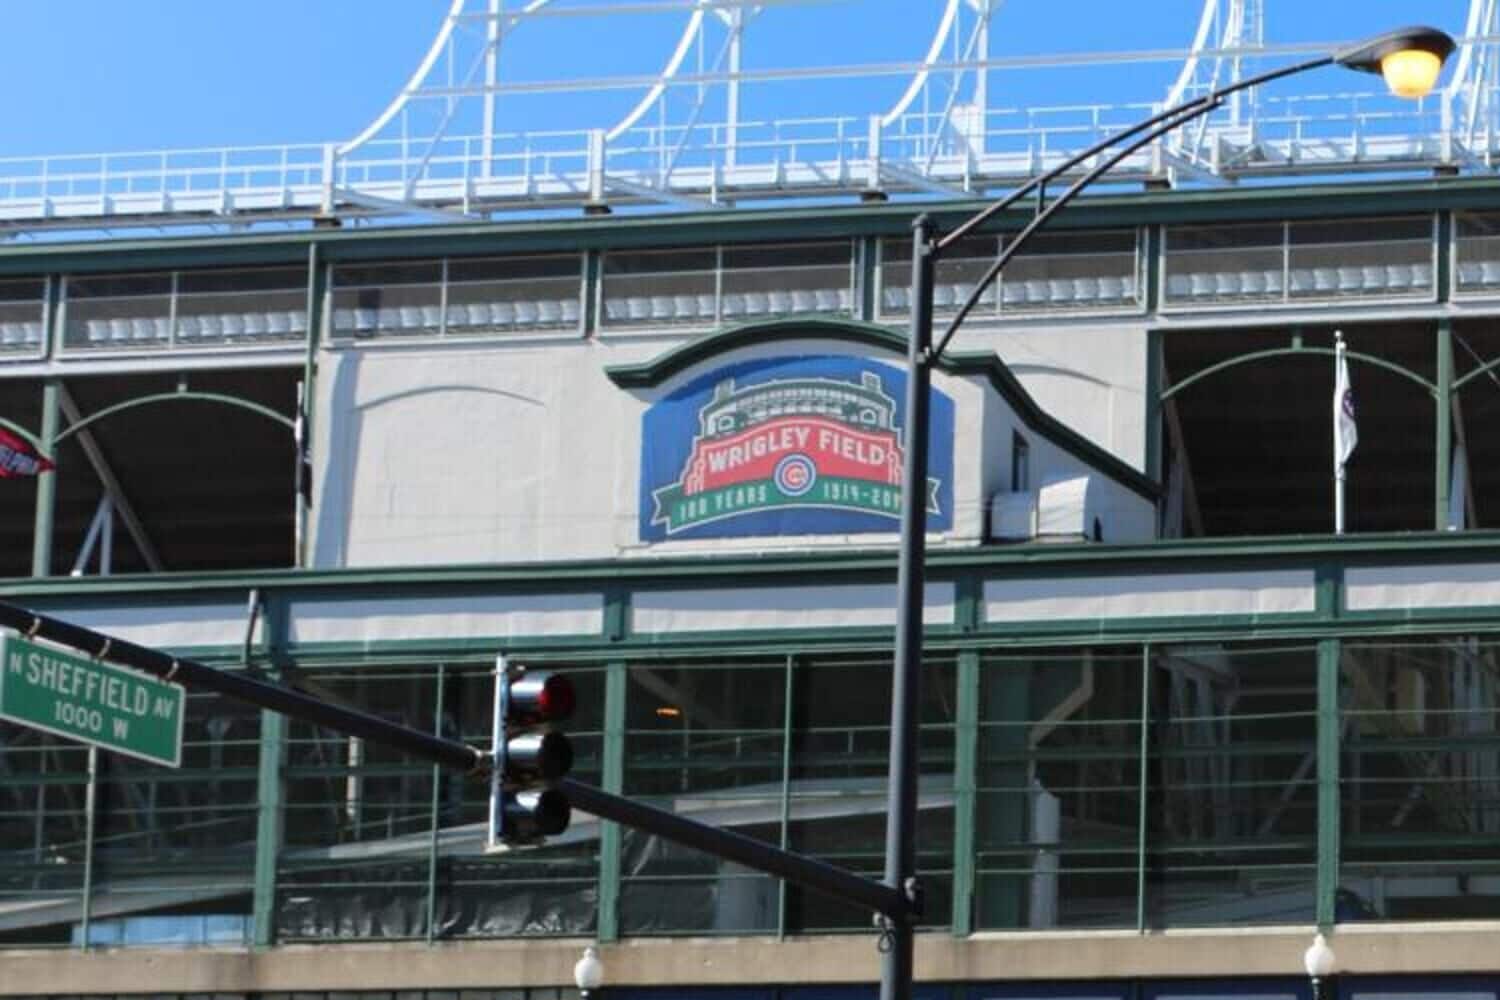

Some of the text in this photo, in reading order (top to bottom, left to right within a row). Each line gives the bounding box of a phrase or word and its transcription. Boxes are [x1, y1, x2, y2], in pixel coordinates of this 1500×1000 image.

[708, 426, 885, 473] WRIGLEY FIELD
[680, 486, 767, 521] 100 YEARS
[10, 653, 174, 719] N SHEFFIELD AV
[55, 701, 129, 740] 1000 W
